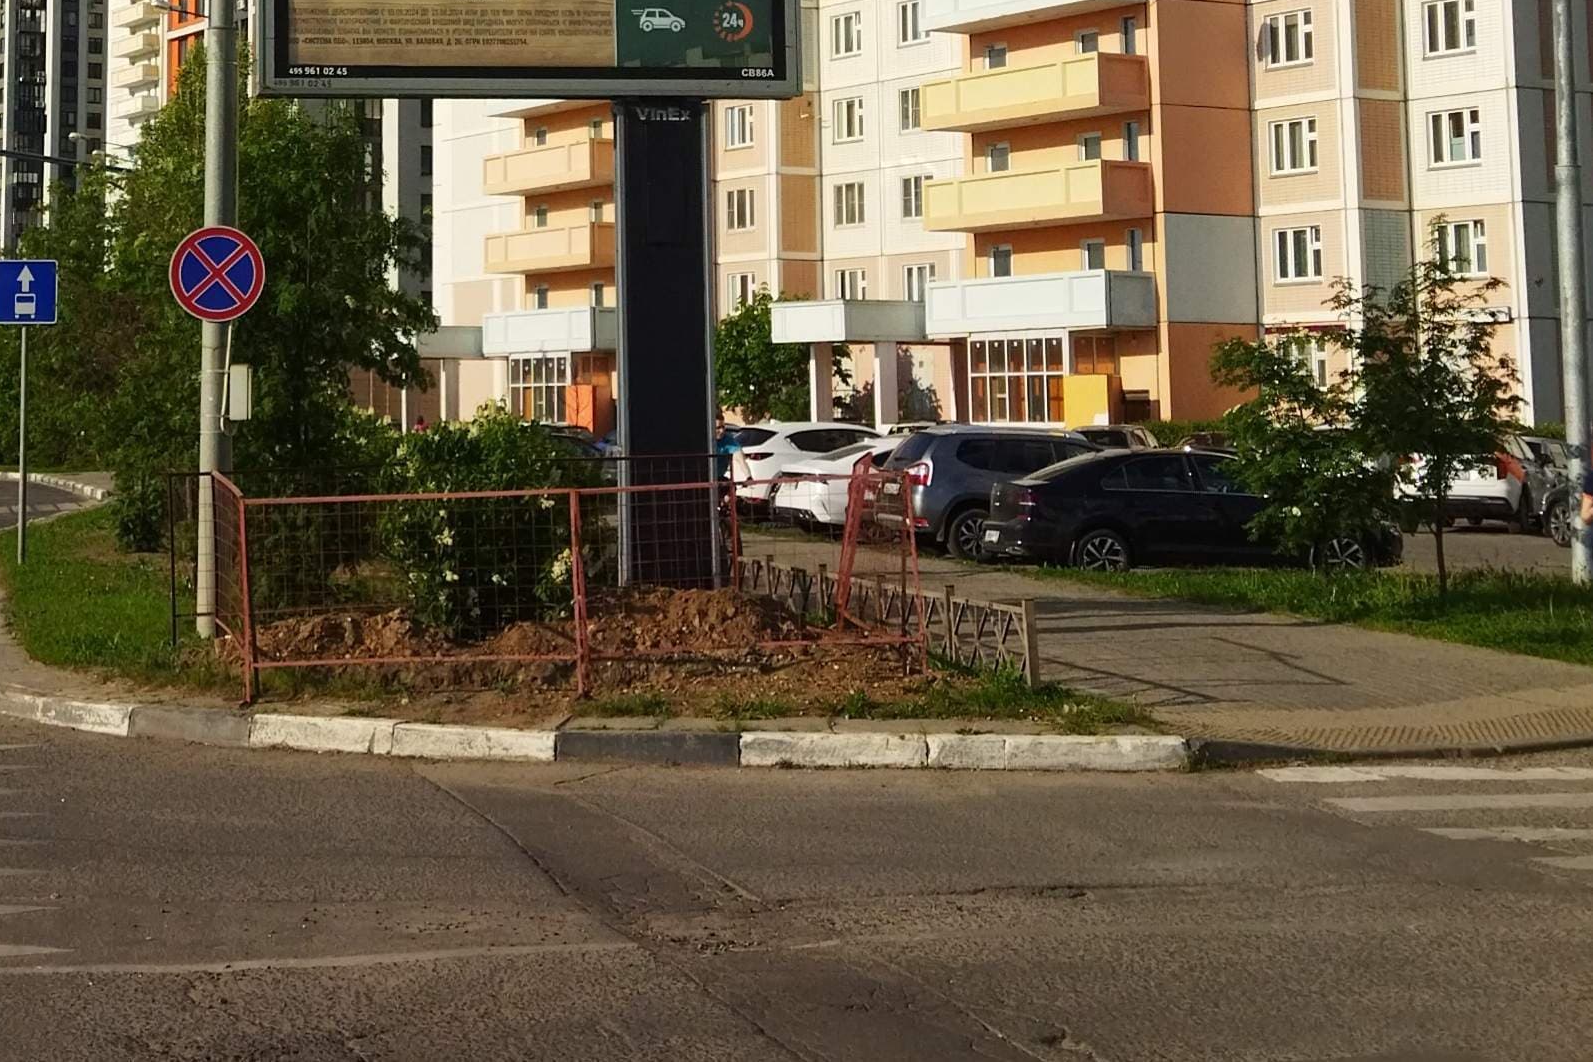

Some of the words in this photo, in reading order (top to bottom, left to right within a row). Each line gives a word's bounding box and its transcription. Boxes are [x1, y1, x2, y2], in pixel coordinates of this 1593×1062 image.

[288, 67, 303, 75] 495
[304, 66, 320, 75] 961
[322, 67, 335, 76] 02
[336, 67, 348, 76] 45
